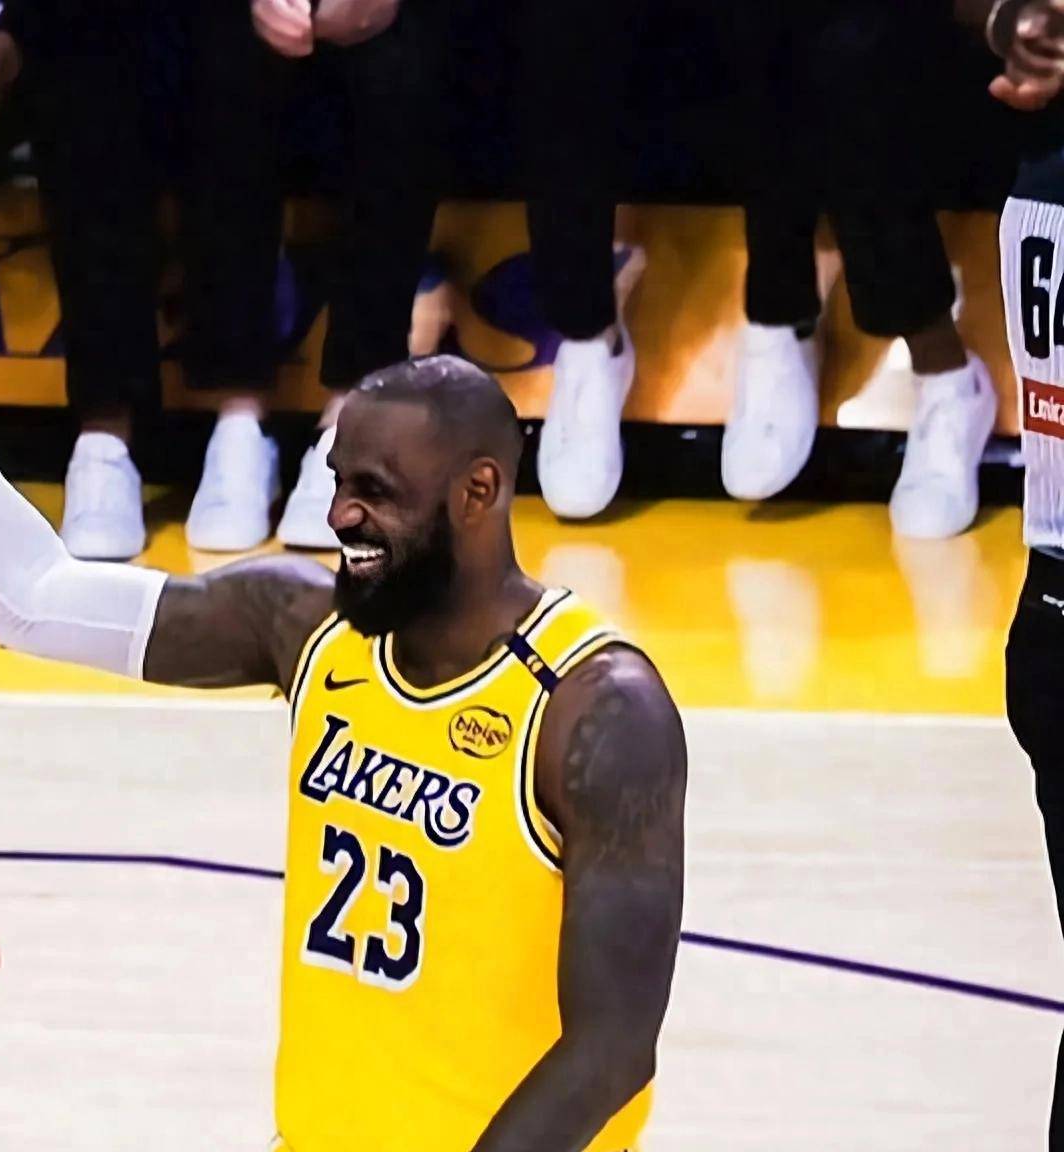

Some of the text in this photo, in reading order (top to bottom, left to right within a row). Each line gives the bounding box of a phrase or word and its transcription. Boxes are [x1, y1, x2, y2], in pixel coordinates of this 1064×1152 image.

[1021, 236, 1064, 359] 6
[298, 713, 483, 849] LAKERS
[303, 822, 426, 986] 23
